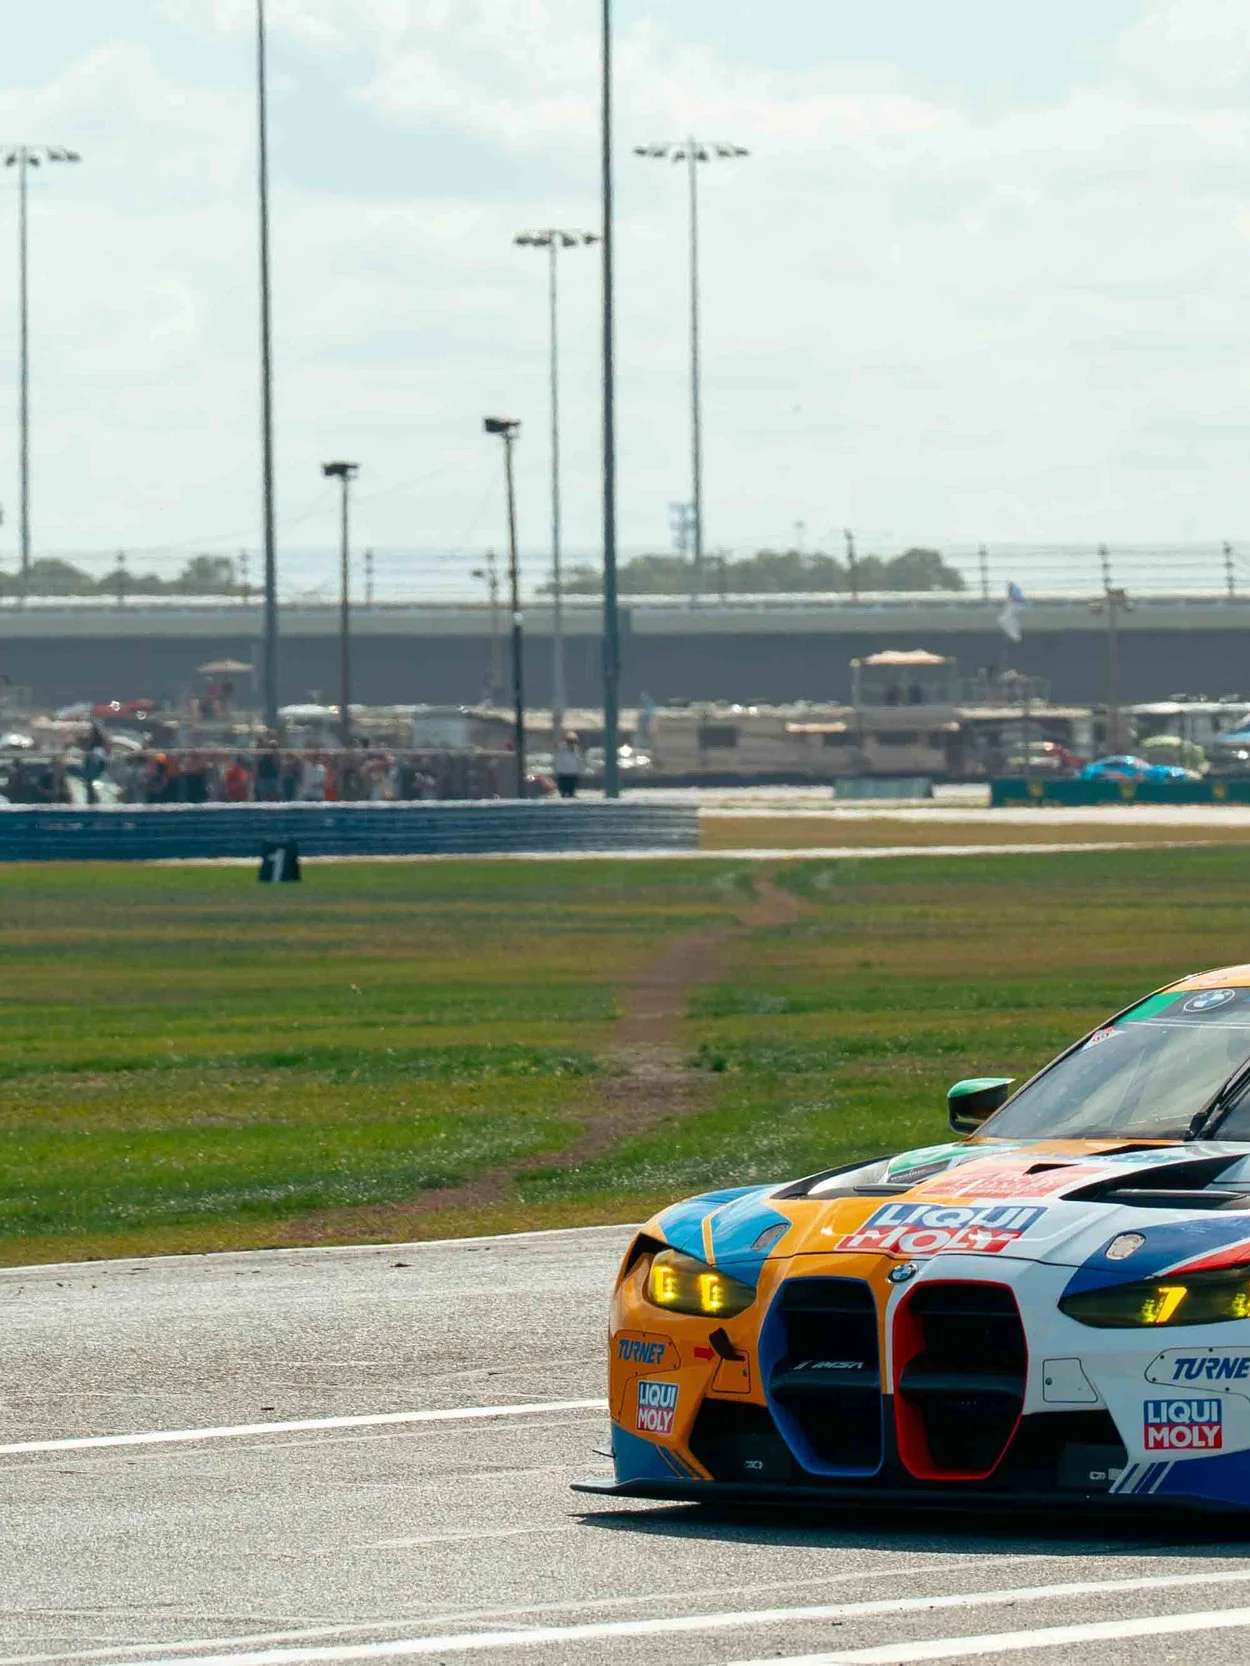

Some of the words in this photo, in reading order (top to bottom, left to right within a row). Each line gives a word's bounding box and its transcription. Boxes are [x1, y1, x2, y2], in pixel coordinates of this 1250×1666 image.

[267, 847, 287, 882] 1
[873, 1203, 1039, 1231] LIQUI
[847, 1226, 1021, 1253] MOLY
[617, 1339, 666, 1365] TURNER
[639, 1383, 677, 1409] LIQUI
[637, 1408, 674, 1432] MOLY
[1147, 1400, 1218, 1425] LIQUI
[1147, 1425, 1221, 1448] MOLY
